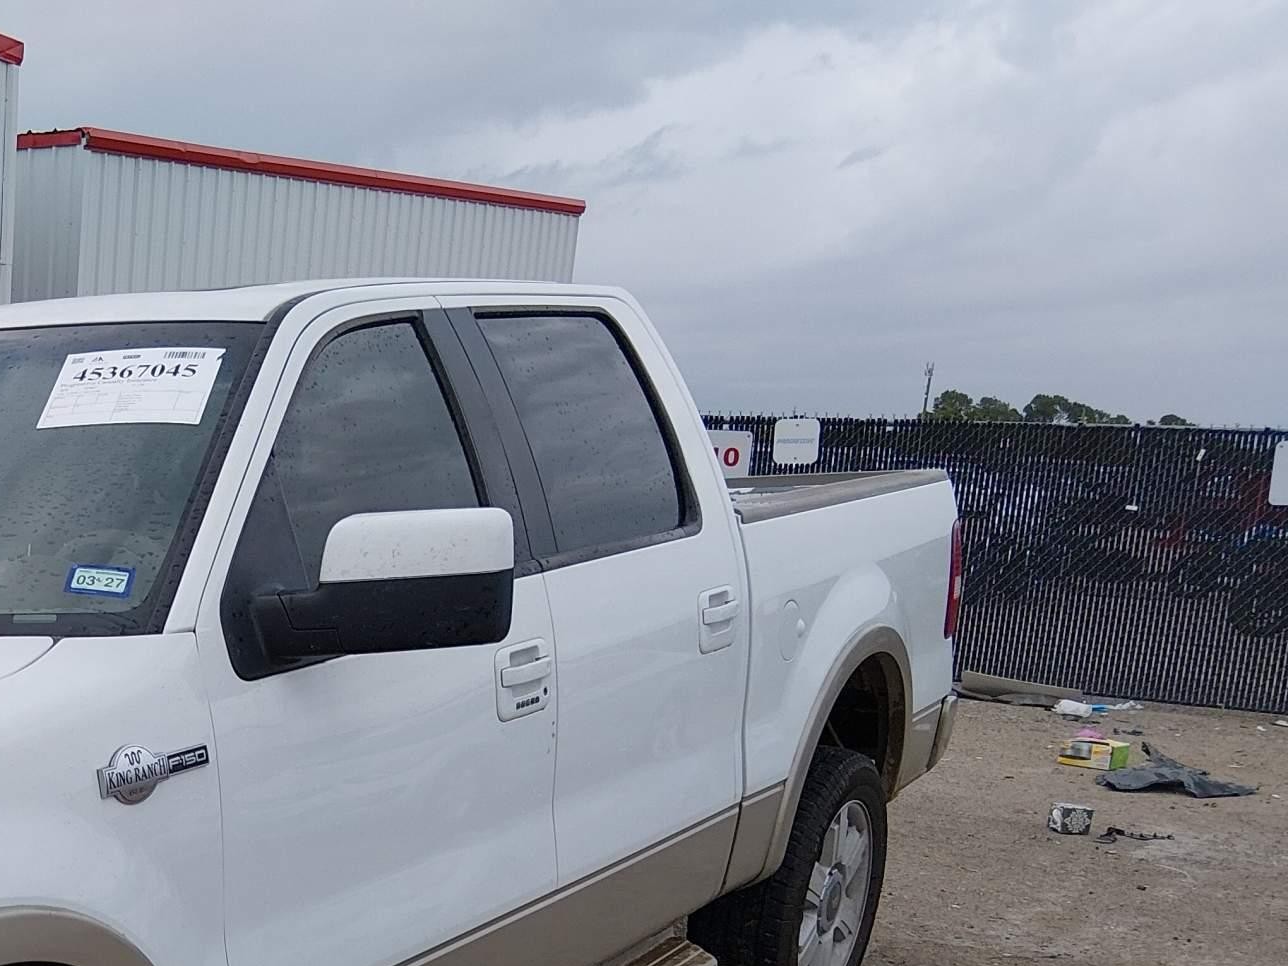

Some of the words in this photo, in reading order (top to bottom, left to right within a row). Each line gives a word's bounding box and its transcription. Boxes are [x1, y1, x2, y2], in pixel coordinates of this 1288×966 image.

[73, 363, 200, 382] 45367045
[76, 575, 96, 586] 03
[104, 577, 125, 589] 27
[107, 769, 133, 790] KING
[134, 757, 166, 783] RANCH
